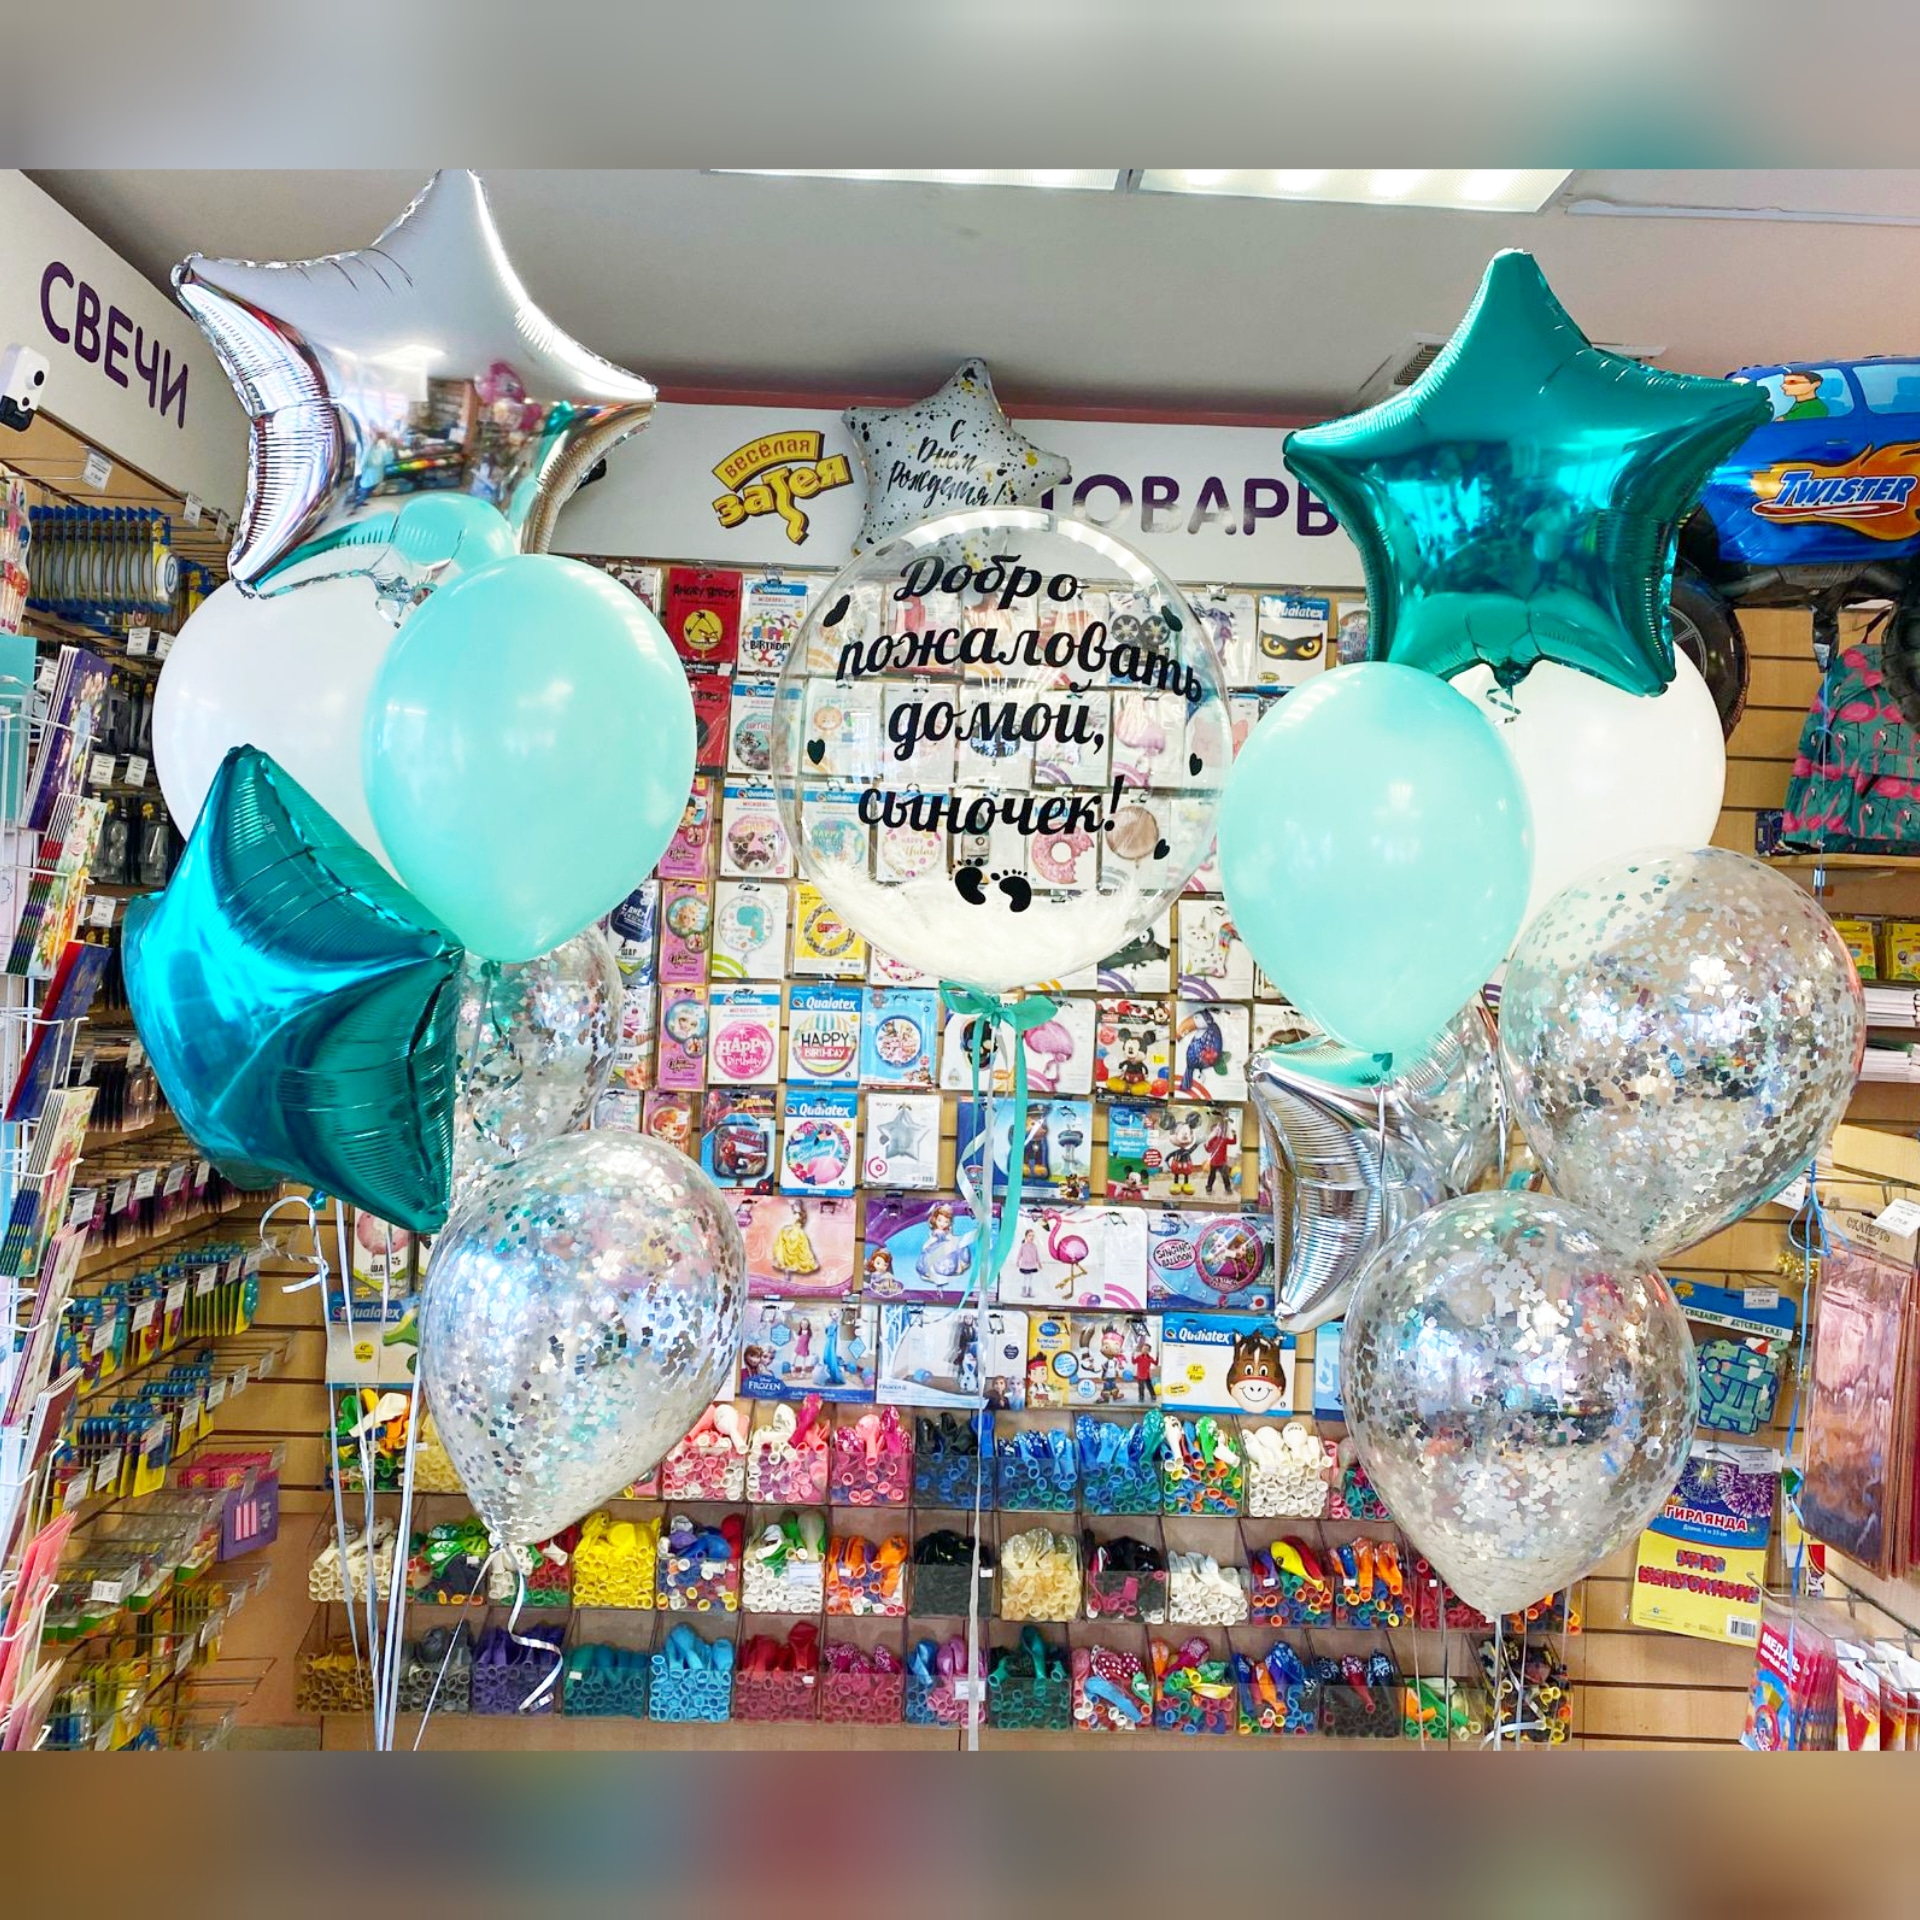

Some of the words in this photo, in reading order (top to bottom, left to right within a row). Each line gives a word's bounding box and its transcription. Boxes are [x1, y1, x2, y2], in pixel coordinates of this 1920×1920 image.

[40, 261, 189, 430] СВЕЧИ
[725, 437, 811, 479] весёлая
[1775, 470, 1918, 508] TWISTER
[893, 554, 1090, 610] Добро
[835, 620, 1202, 703] пожаловать
[888, 679, 1106, 762] домой,
[857, 774, 1126, 836] сыночек!
[806, 996, 857, 1011] Qualatex
[801, 1032, 850, 1047] HAPPY
[804, 1049, 845, 1058] BIRTHDAY
[799, 1103, 850, 1118] Qualatex
[1155, 1242, 1192, 1258] SINGING
[1161, 1252, 1193, 1268] BALLOON
[1178, 1328, 1231, 1344] Qualatex
[748, 1380, 781, 1391] FROZEN
[1665, 1504, 1748, 1533] ГИРЛЯНДА
